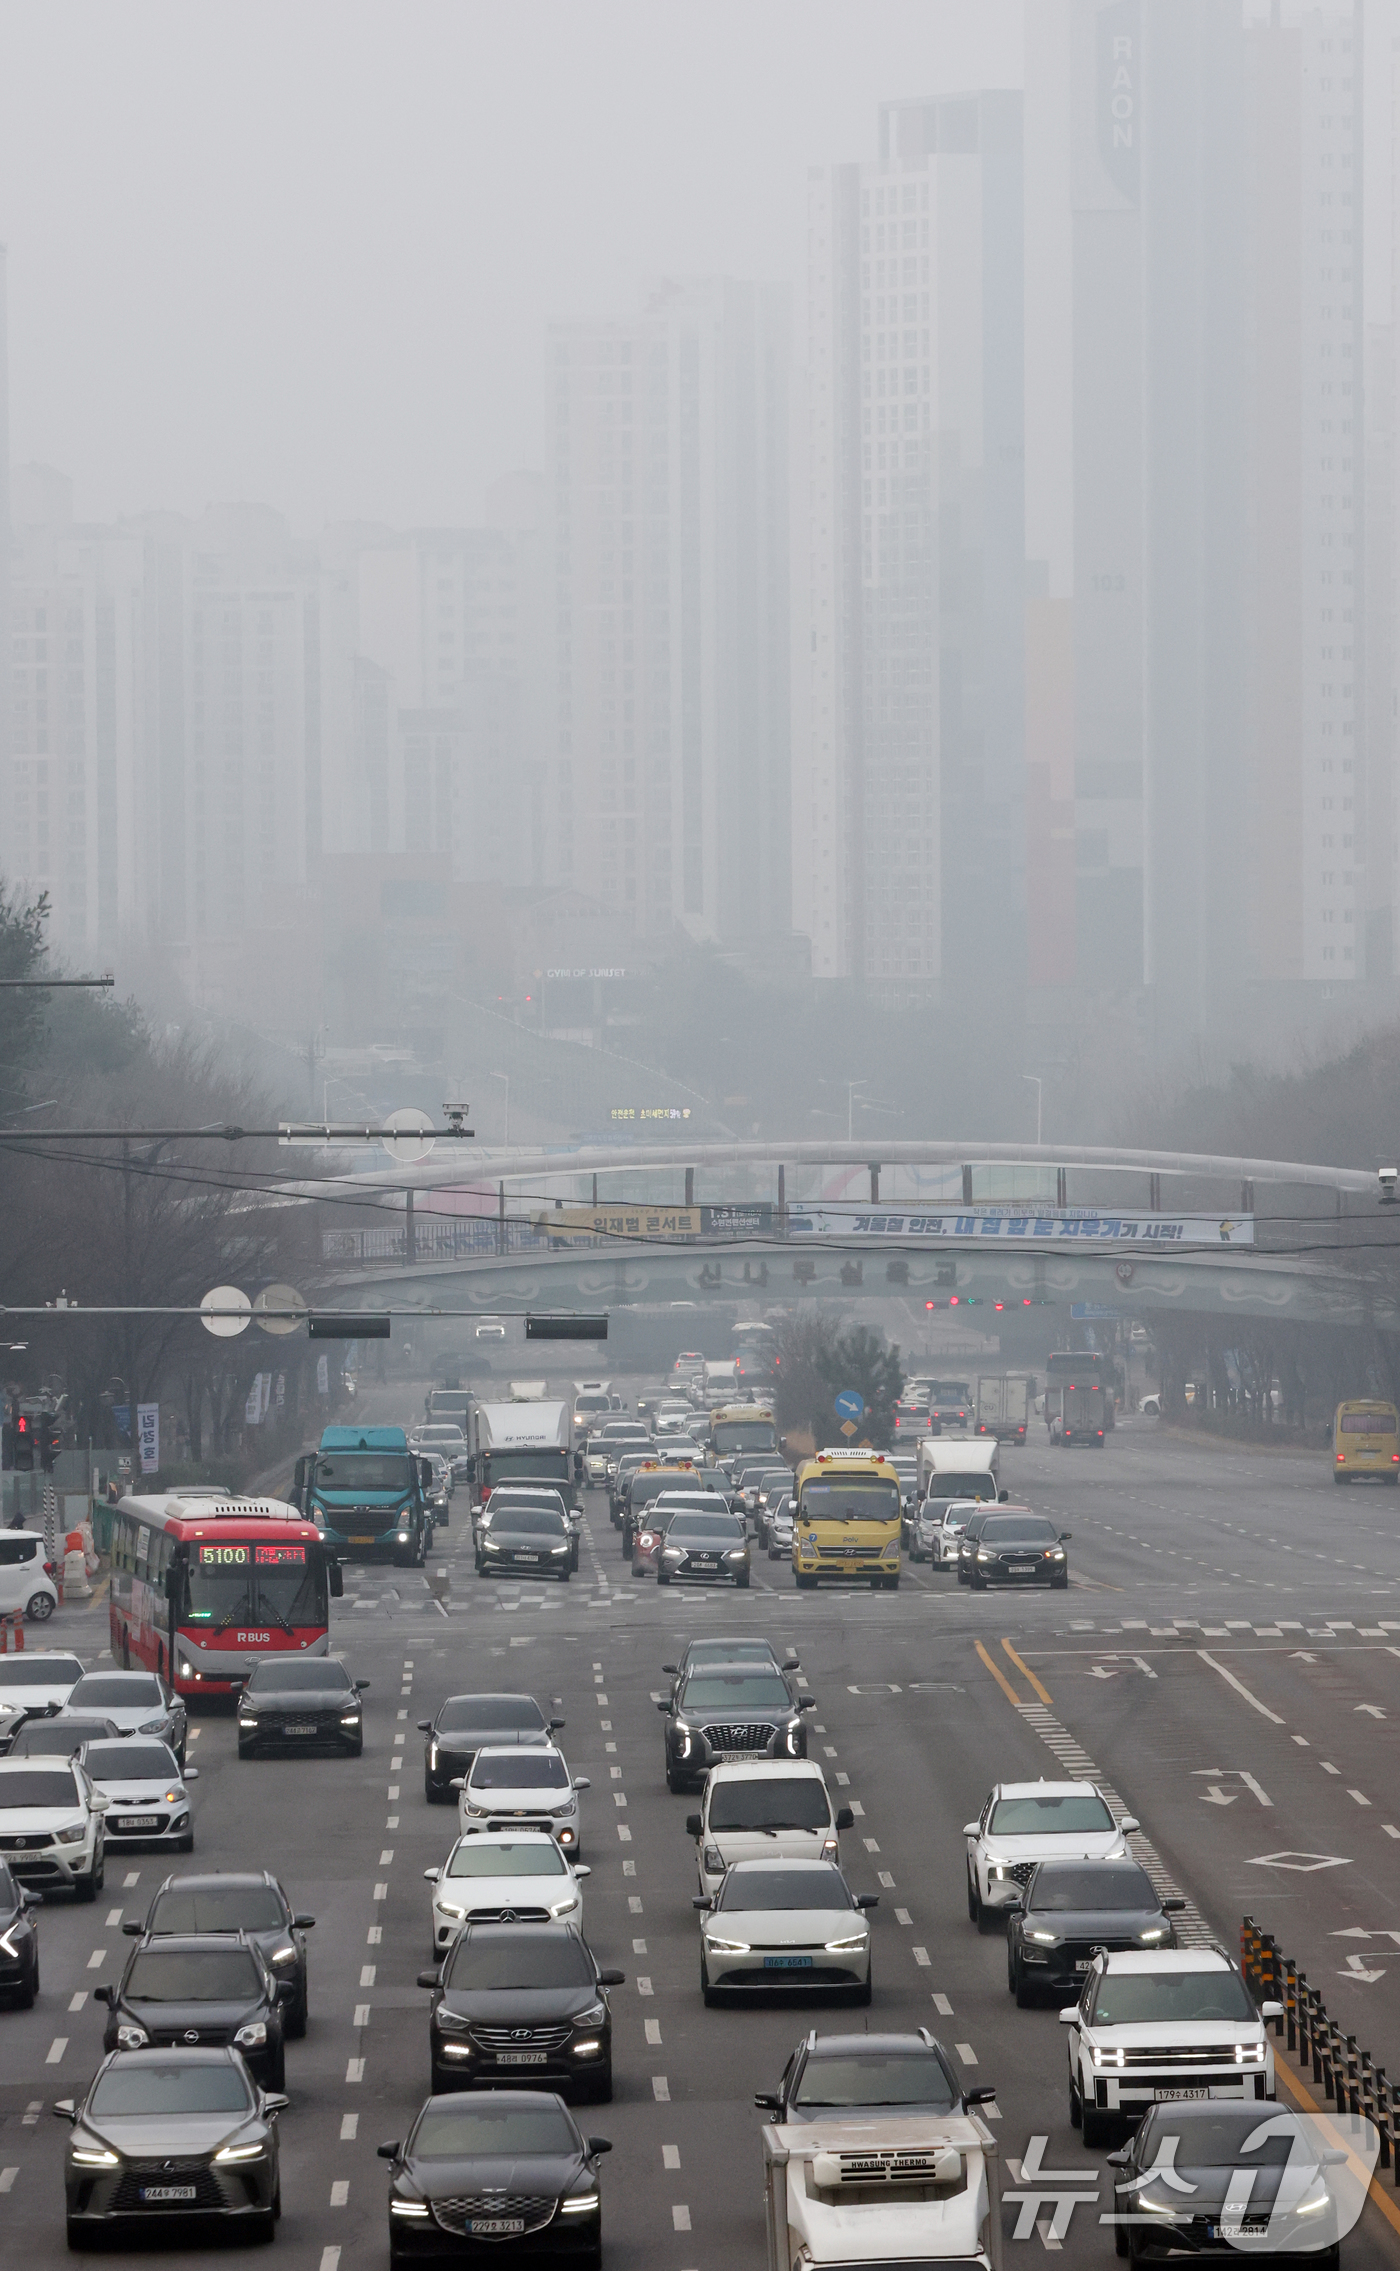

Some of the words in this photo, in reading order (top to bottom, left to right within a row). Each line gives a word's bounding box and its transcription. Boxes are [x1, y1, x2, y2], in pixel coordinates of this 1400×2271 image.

[1111, 35, 1134, 148] RAON
[547, 968, 571, 978] GYM
[573, 968, 587, 978] OF
[588, 968, 626, 977] SUNSET
[593, 1217, 640, 1233] 임재범
[646, 1215, 692, 1231] 콘서트
[853, 1216, 905, 1232] 겨울철
[908, 1218, 948, 1236] 안전,
[955, 1216, 977, 1234] 내
[981, 1217, 1003, 1235] 집
[1006, 1217, 1029, 1235] 앞
[1032, 1218, 1055, 1236] 눈
[1142, 1223, 1183, 1239] 시작!
[203, 1548, 246, 1563] 5100
[521, 2054, 543, 2062] 0976
[1158, 2090, 1181, 2099] 179수
[1183, 2089, 1206, 2098] 4317
[851, 2160, 891, 2168] HWASUNG
[893, 2158, 927, 2167] THERMO
[171, 2188, 193, 2197] 7981
[499, 2220, 523, 2230] 3213
